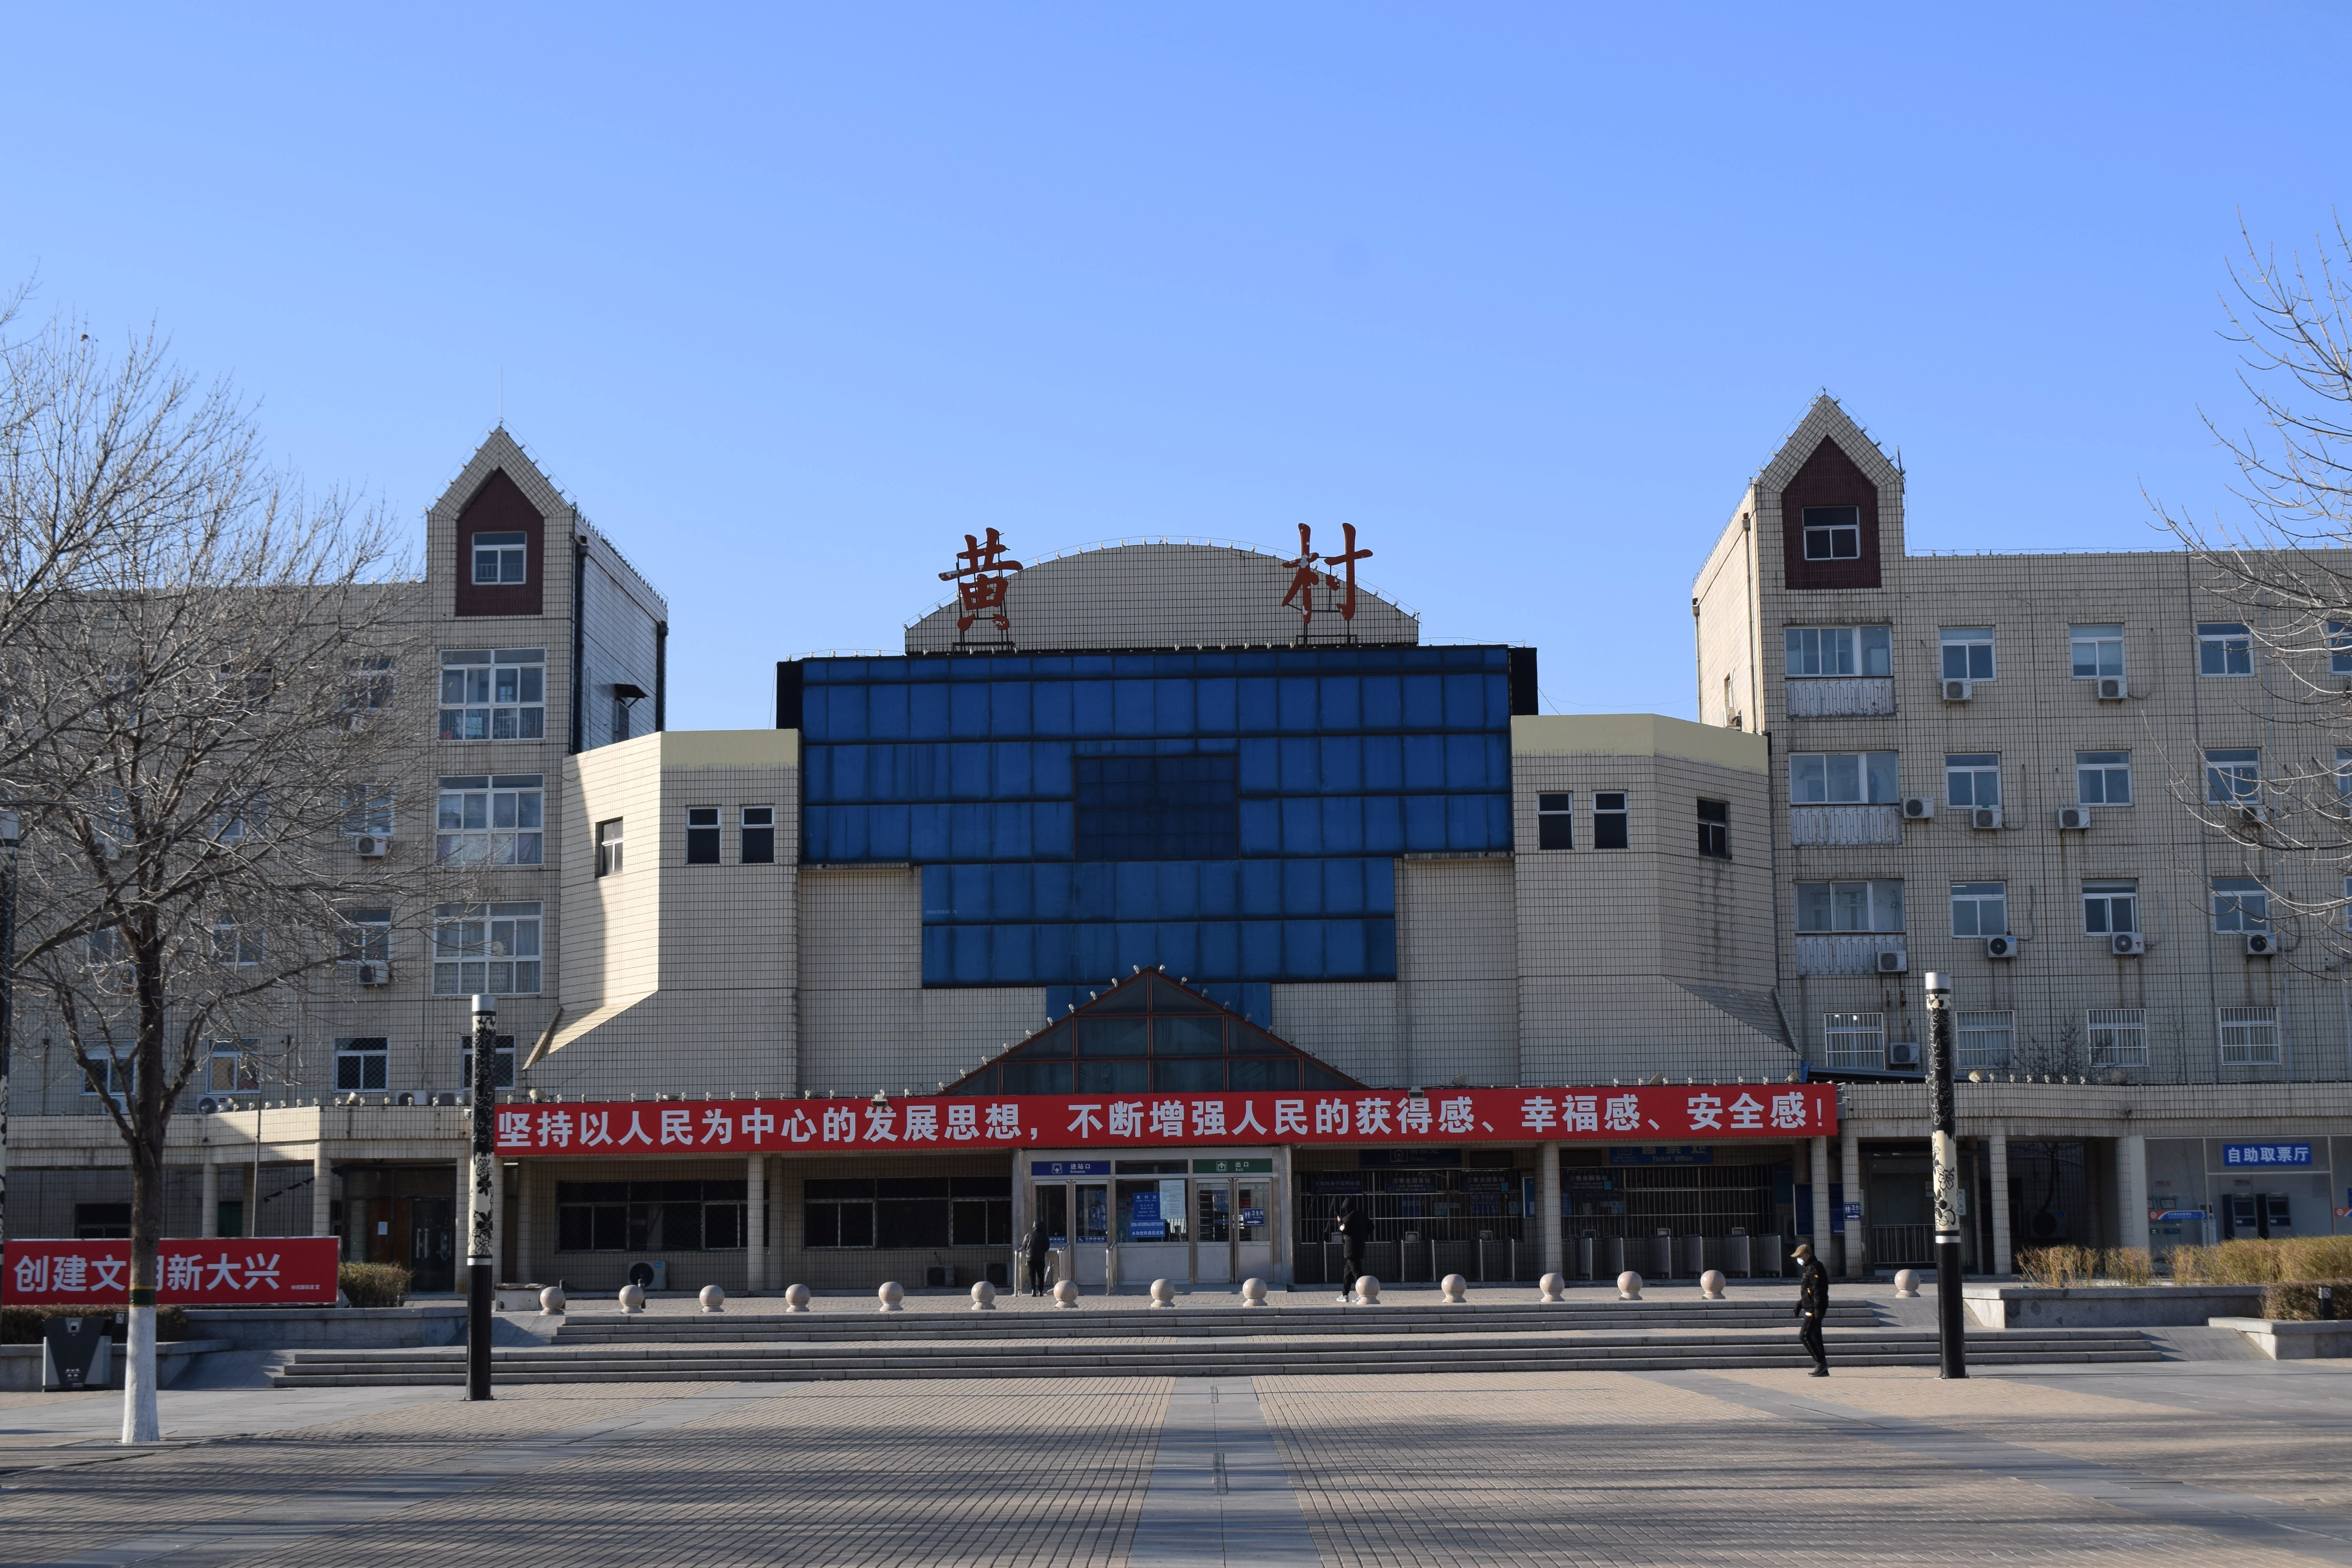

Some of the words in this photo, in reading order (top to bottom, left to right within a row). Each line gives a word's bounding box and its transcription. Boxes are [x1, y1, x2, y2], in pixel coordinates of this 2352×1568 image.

[497, 1091, 1822, 1147] 坚持以人民为中心的发展思想，不断增强人民的获得感、幸福感、安全感！
[2228, 1147, 2309, 1163] 自助取票厅
